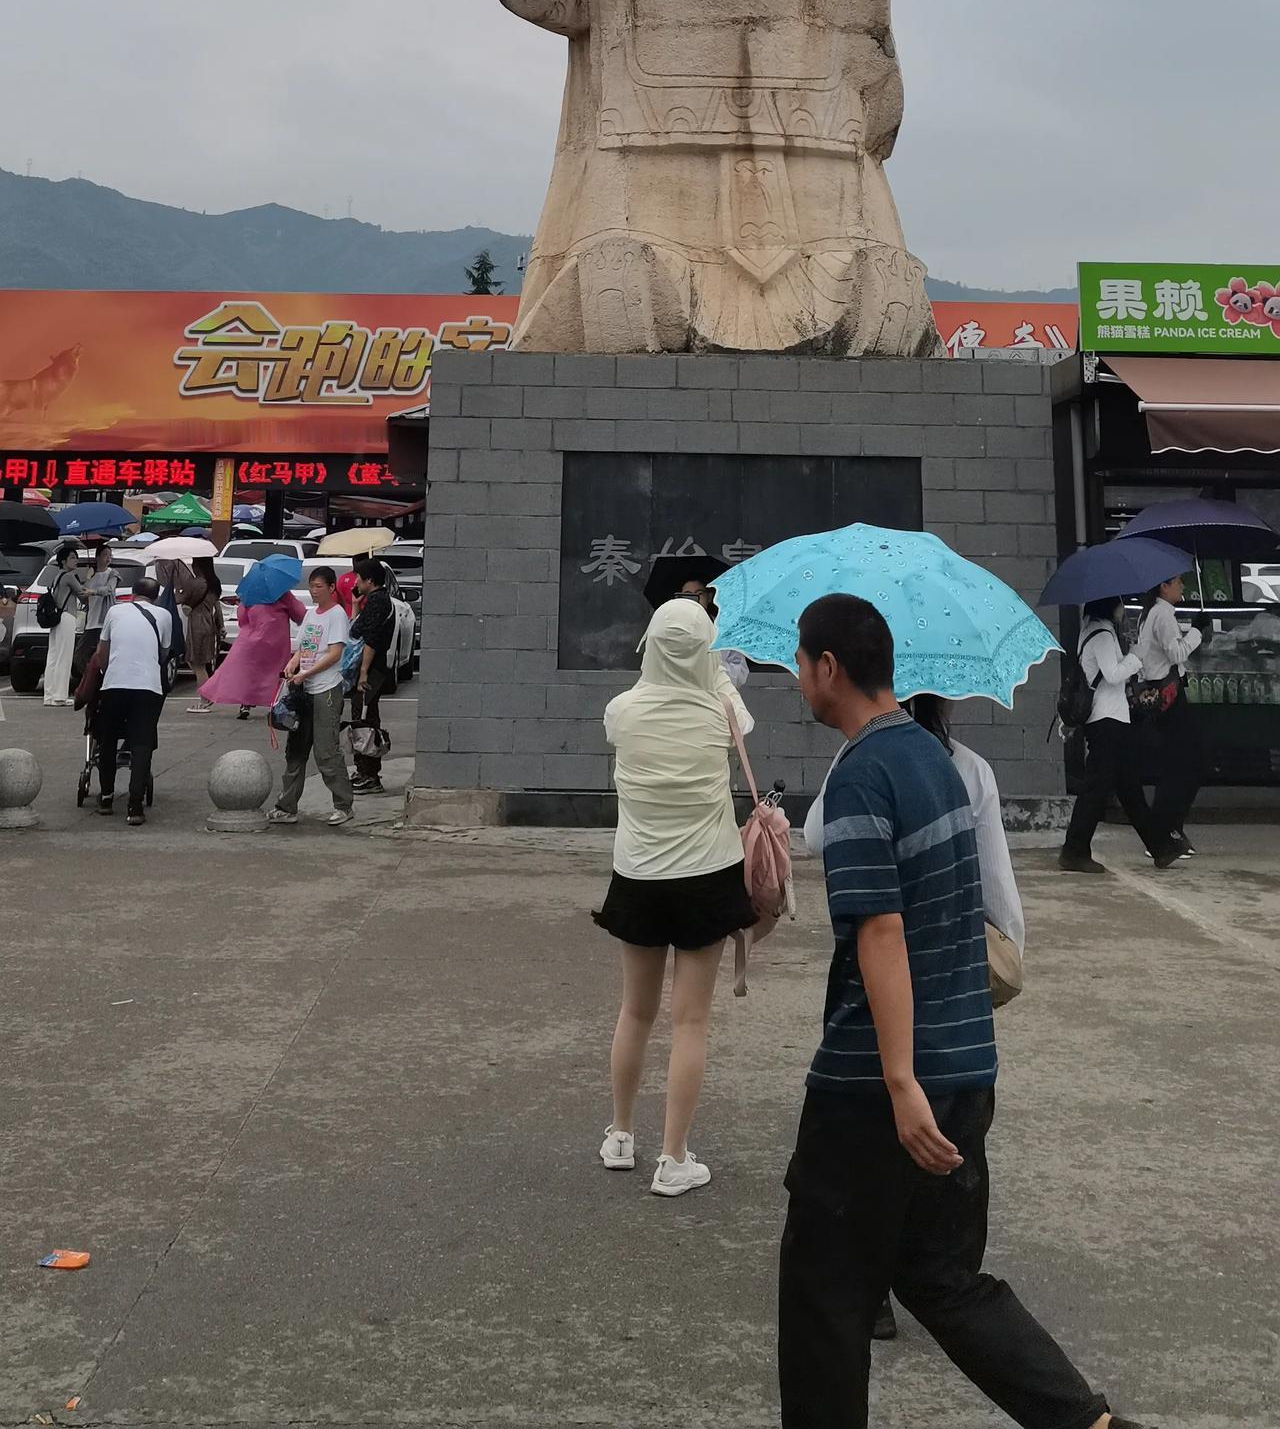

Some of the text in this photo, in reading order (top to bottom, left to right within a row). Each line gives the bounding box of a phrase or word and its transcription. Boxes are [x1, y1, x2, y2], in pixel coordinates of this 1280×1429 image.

[1096, 279, 1209, 321] 果赖
[1097, 325, 1150, 339] 熊猫雪糕
[1154, 327, 1261, 339] PANDA ICE CREAM
[238, 461, 327, 485] 《红马甲》
